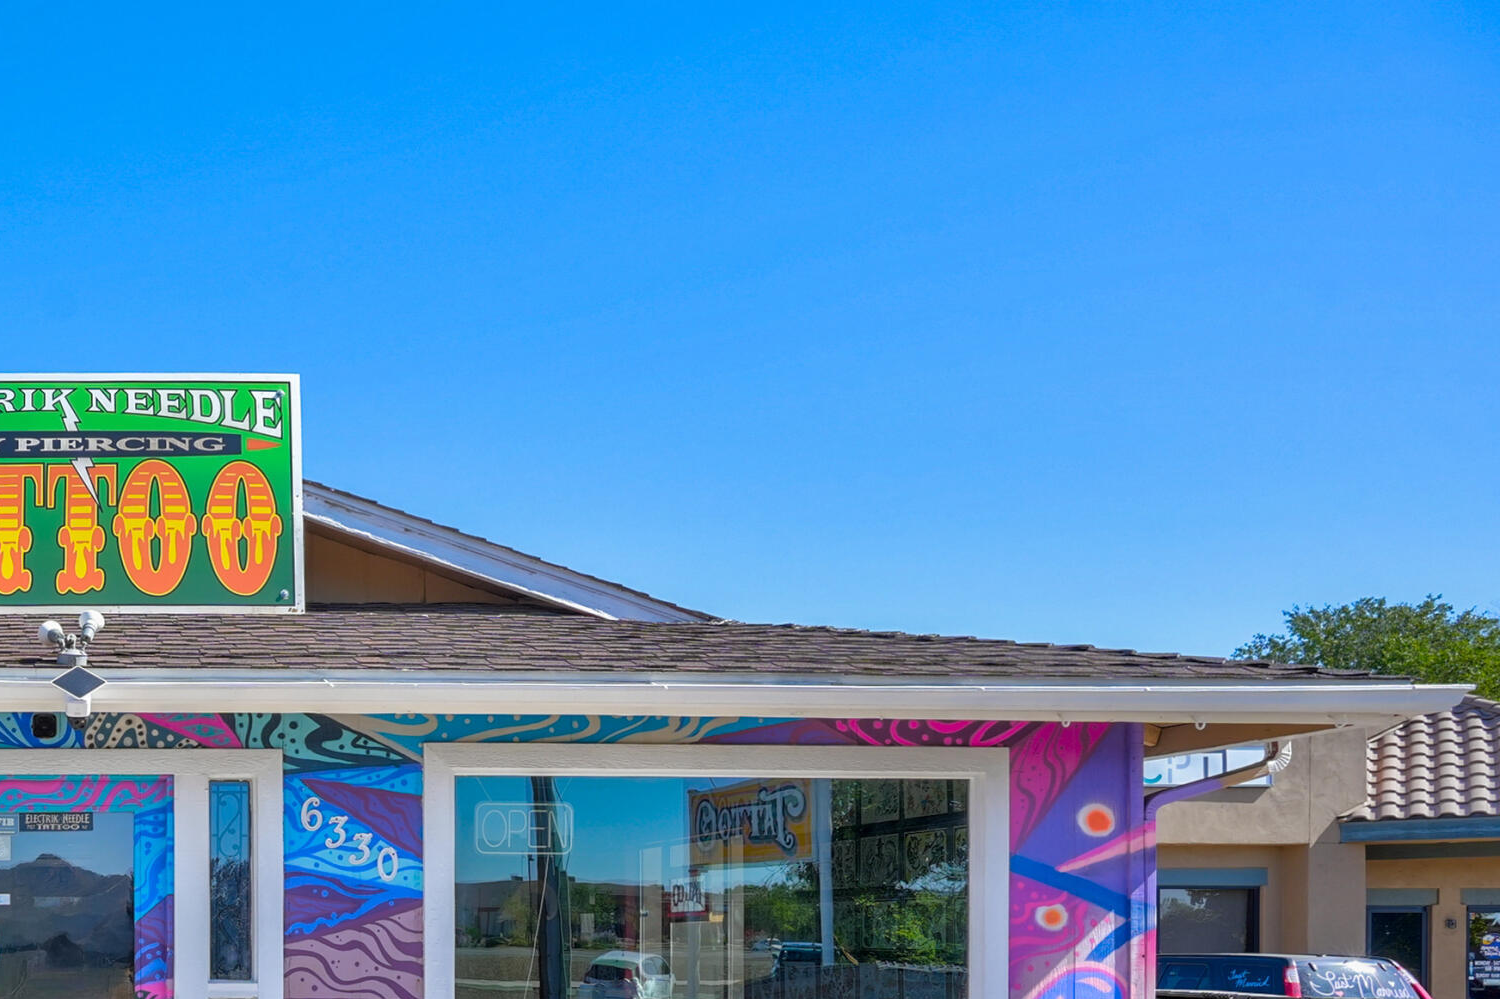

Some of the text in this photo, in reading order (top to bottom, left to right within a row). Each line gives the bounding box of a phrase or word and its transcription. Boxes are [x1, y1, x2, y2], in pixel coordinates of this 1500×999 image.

[84, 387, 283, 439] NEEDLE
[15, 437, 226, 453] PIERCING
[25, 813, 90, 824] ELECTRIK NEEDLE
[482, 809, 567, 848] OPEN
[301, 797, 398, 881] 6330
